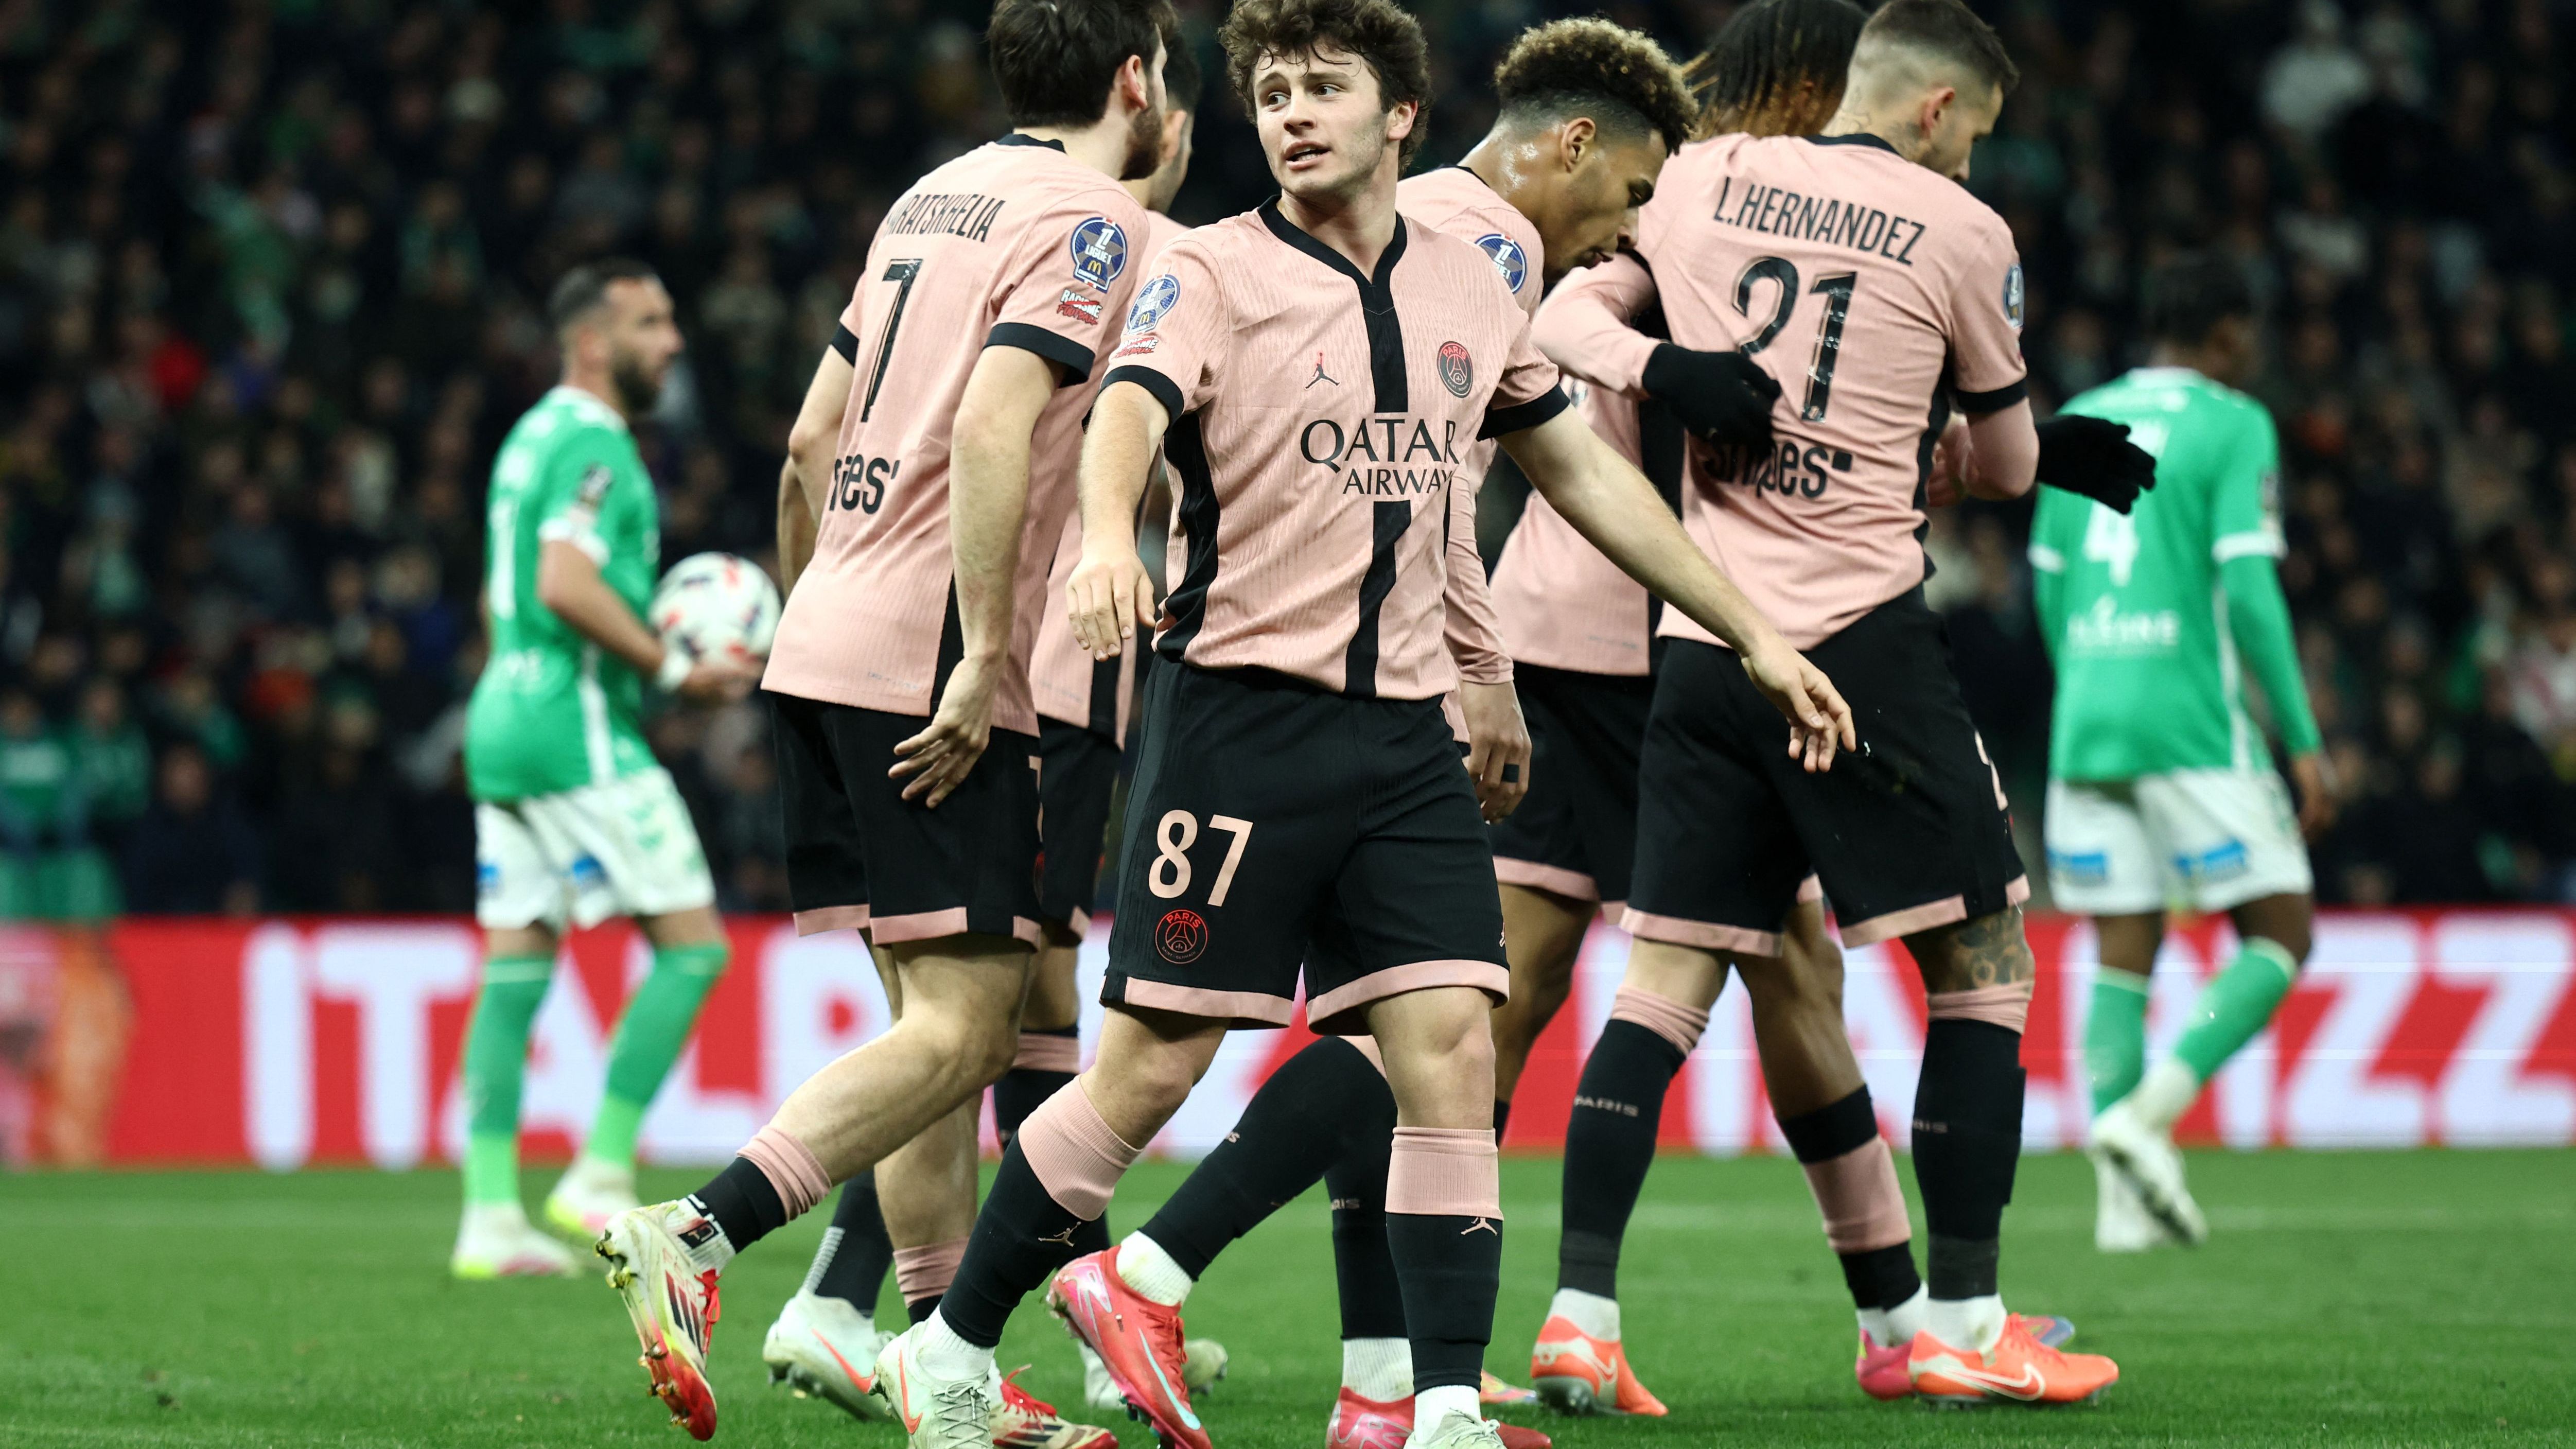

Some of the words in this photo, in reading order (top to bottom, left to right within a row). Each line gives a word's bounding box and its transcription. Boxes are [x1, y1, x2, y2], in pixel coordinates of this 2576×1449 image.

[886, 194, 1006, 243] RATSKHELIA
[1713, 177, 1926, 266] L.HERNANDEZ
[860, 258, 924, 423] 7
[1443, 345, 1467, 360] PARIS
[1732, 256, 1857, 424] 21
[1300, 417, 1460, 474] QATAR
[1342, 467, 1453, 495] AIRWAY
[1148, 809, 1253, 907] 87
[1166, 912, 1201, 929] PARIS
[1573, 1095, 1639, 1118] PARIS
